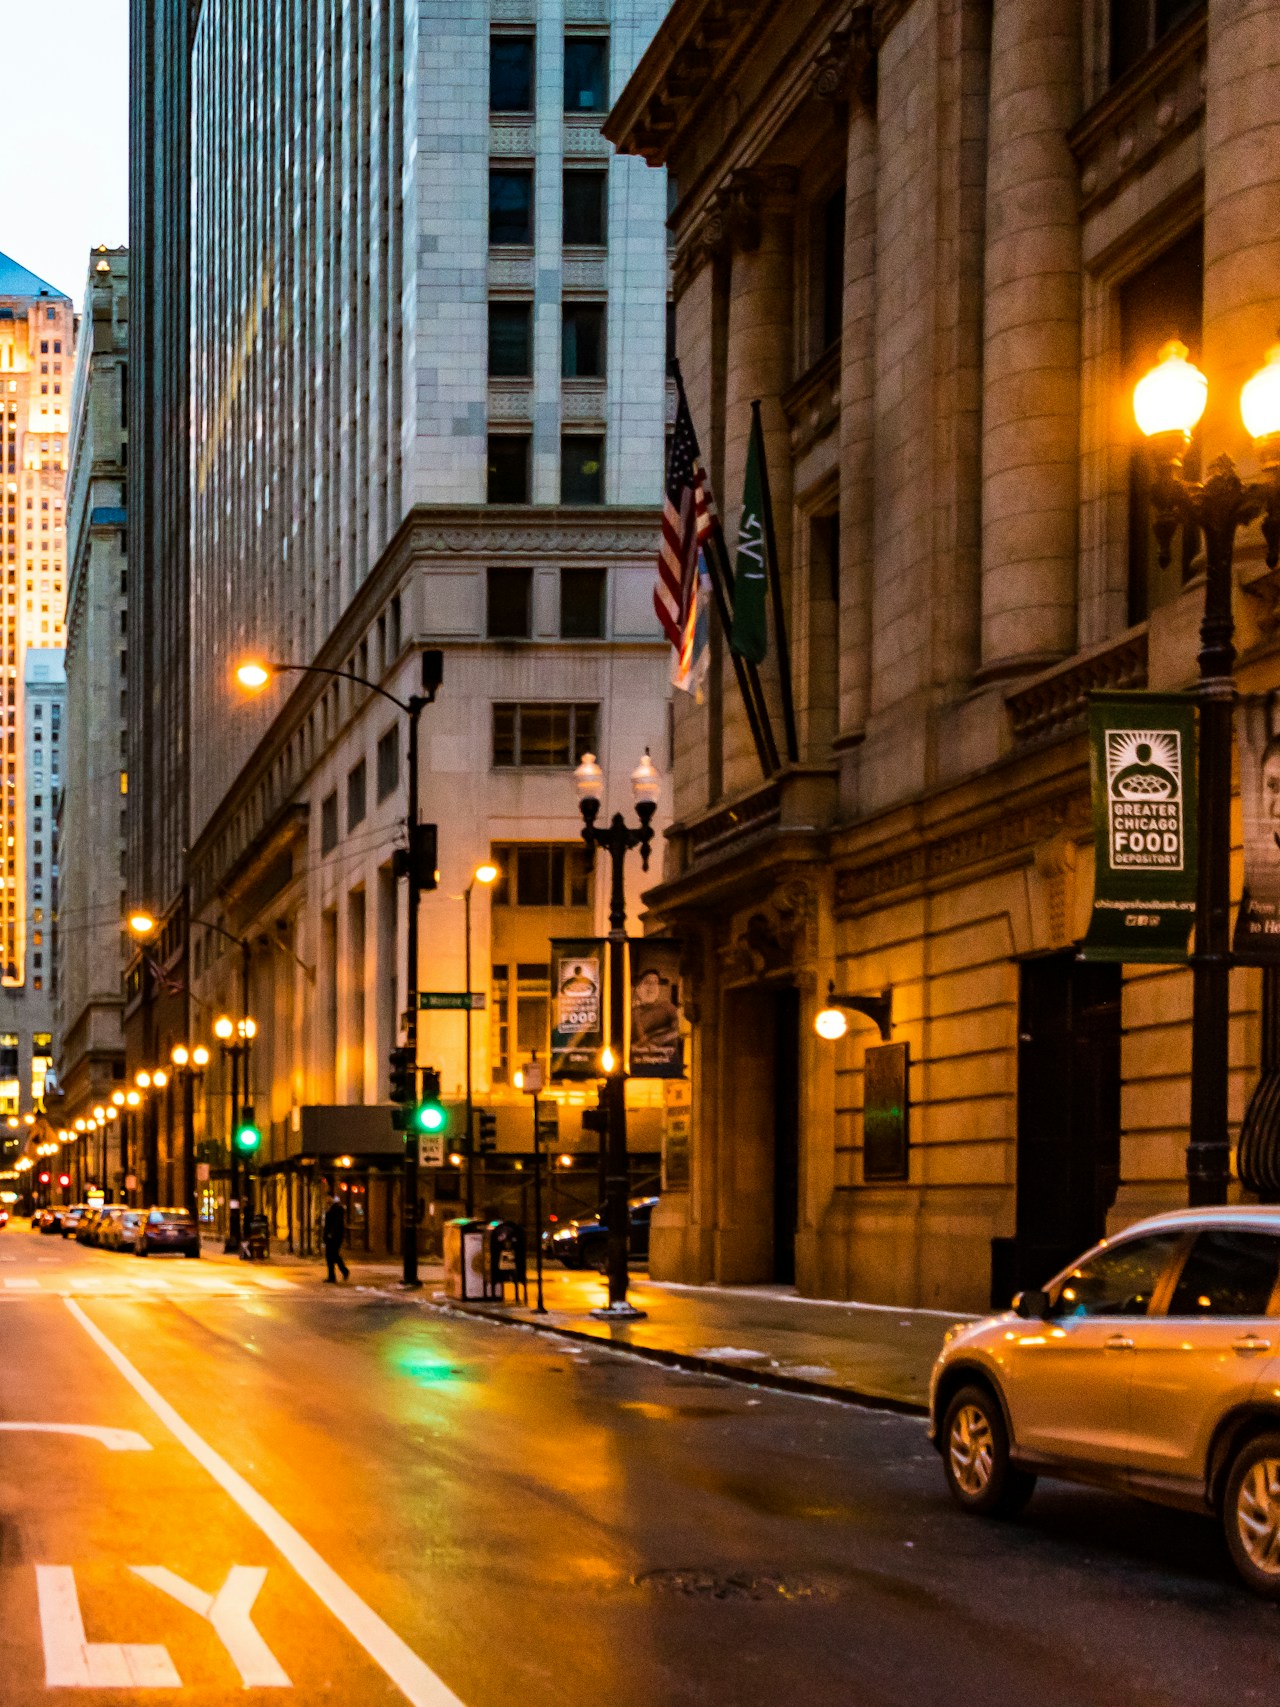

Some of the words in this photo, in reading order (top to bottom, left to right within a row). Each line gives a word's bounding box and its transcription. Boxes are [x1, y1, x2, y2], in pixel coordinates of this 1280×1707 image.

[1114, 803, 1177, 816] GREATER
[1114, 817, 1178, 831] CHICAGO
[1115, 832, 1178, 852] FOOD
[1115, 853, 1177, 864] DEPOSITORY
